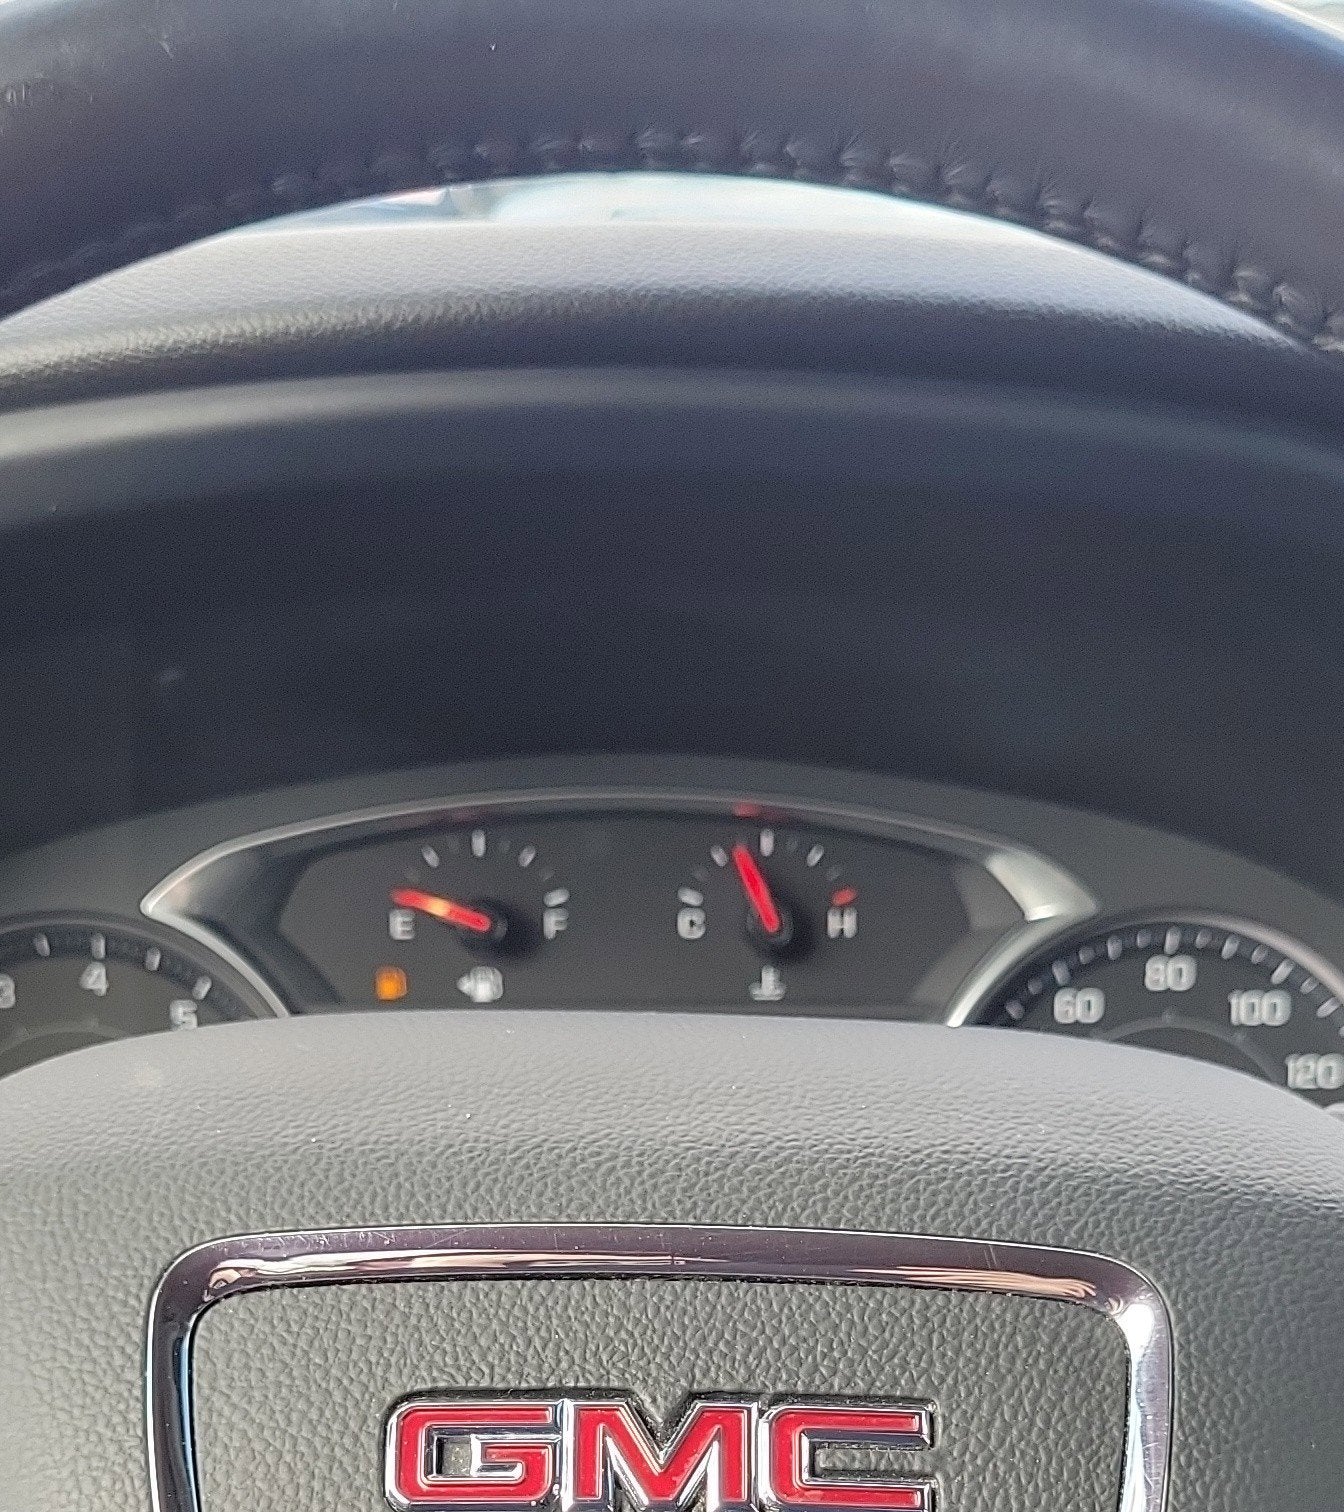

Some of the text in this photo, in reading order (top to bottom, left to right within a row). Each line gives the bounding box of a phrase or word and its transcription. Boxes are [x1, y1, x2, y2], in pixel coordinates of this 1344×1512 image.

[388, 909, 416, 942] E
[542, 907, 570, 940] F
[677, 907, 706, 940] C
[826, 906, 858, 939] H
[80, 961, 109, 997] 4
[1144, 954, 1197, 991] 80
[169, 999, 199, 1031] 5
[1053, 987, 1107, 1025] 60
[1229, 990, 1292, 1027] 100
